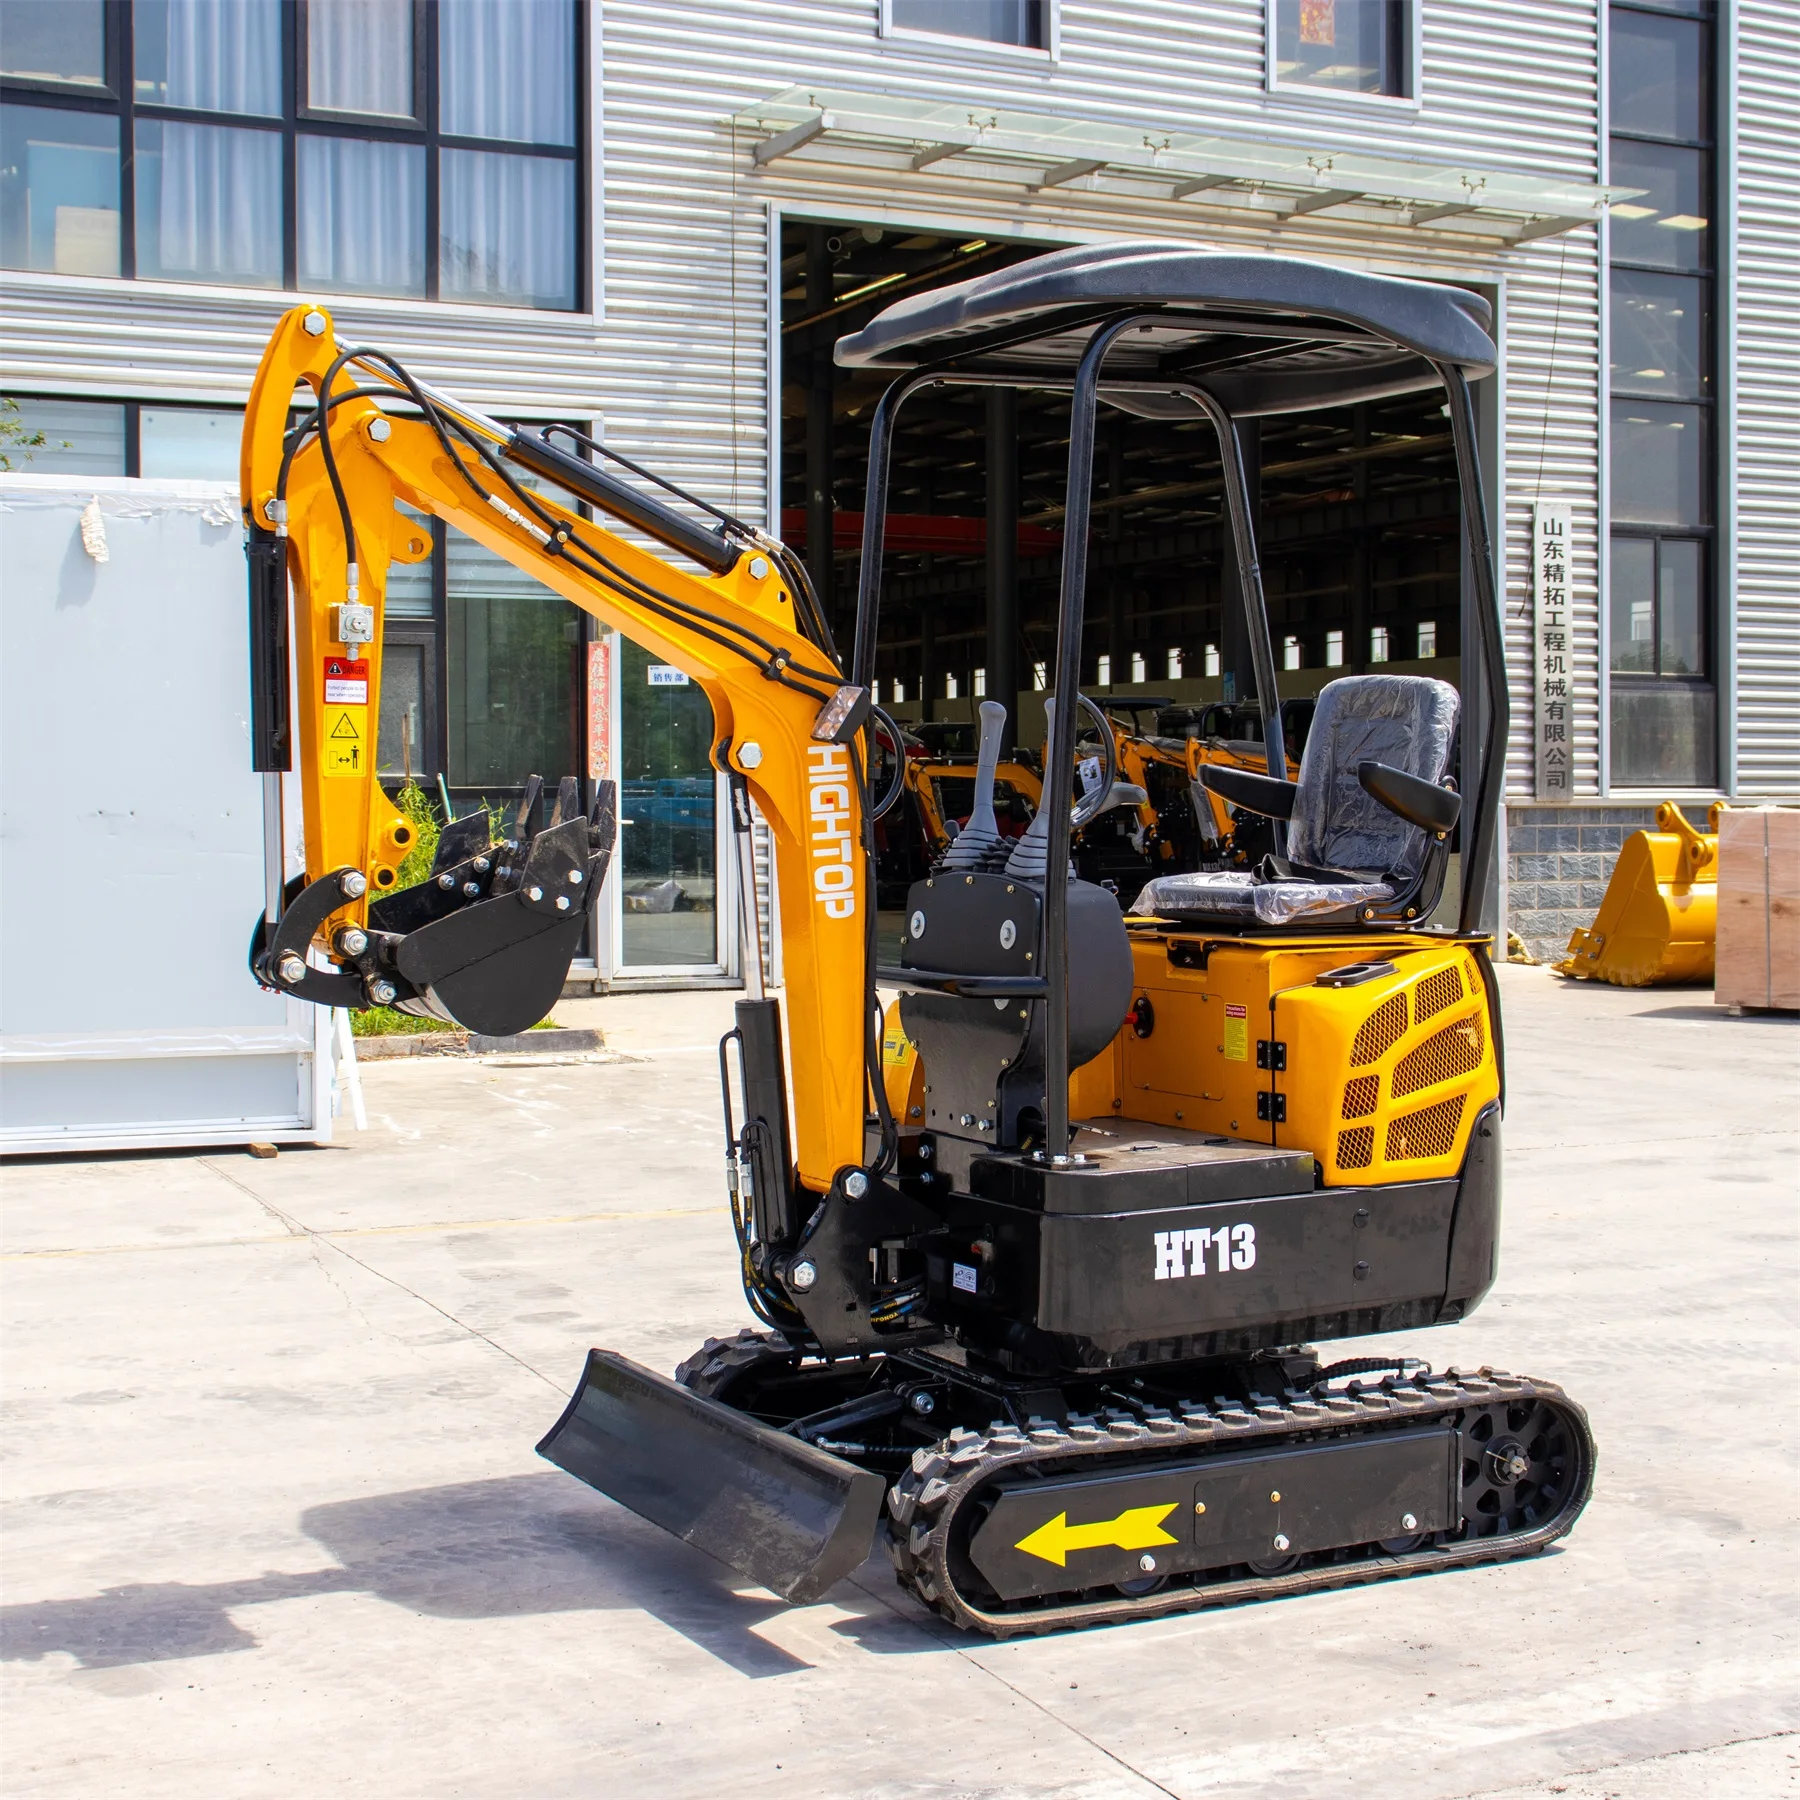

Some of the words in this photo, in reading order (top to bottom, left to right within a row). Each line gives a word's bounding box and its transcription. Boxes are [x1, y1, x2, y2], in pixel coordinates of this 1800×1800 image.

[342, 665, 365, 674] DANGER
[654, 673, 684, 682] 销售部
[1542, 518, 1566, 789] 山东精拓工程机械有限公司
[807, 744, 855, 919] HIGHTOP
[1154, 1223, 1256, 1280] HT13
